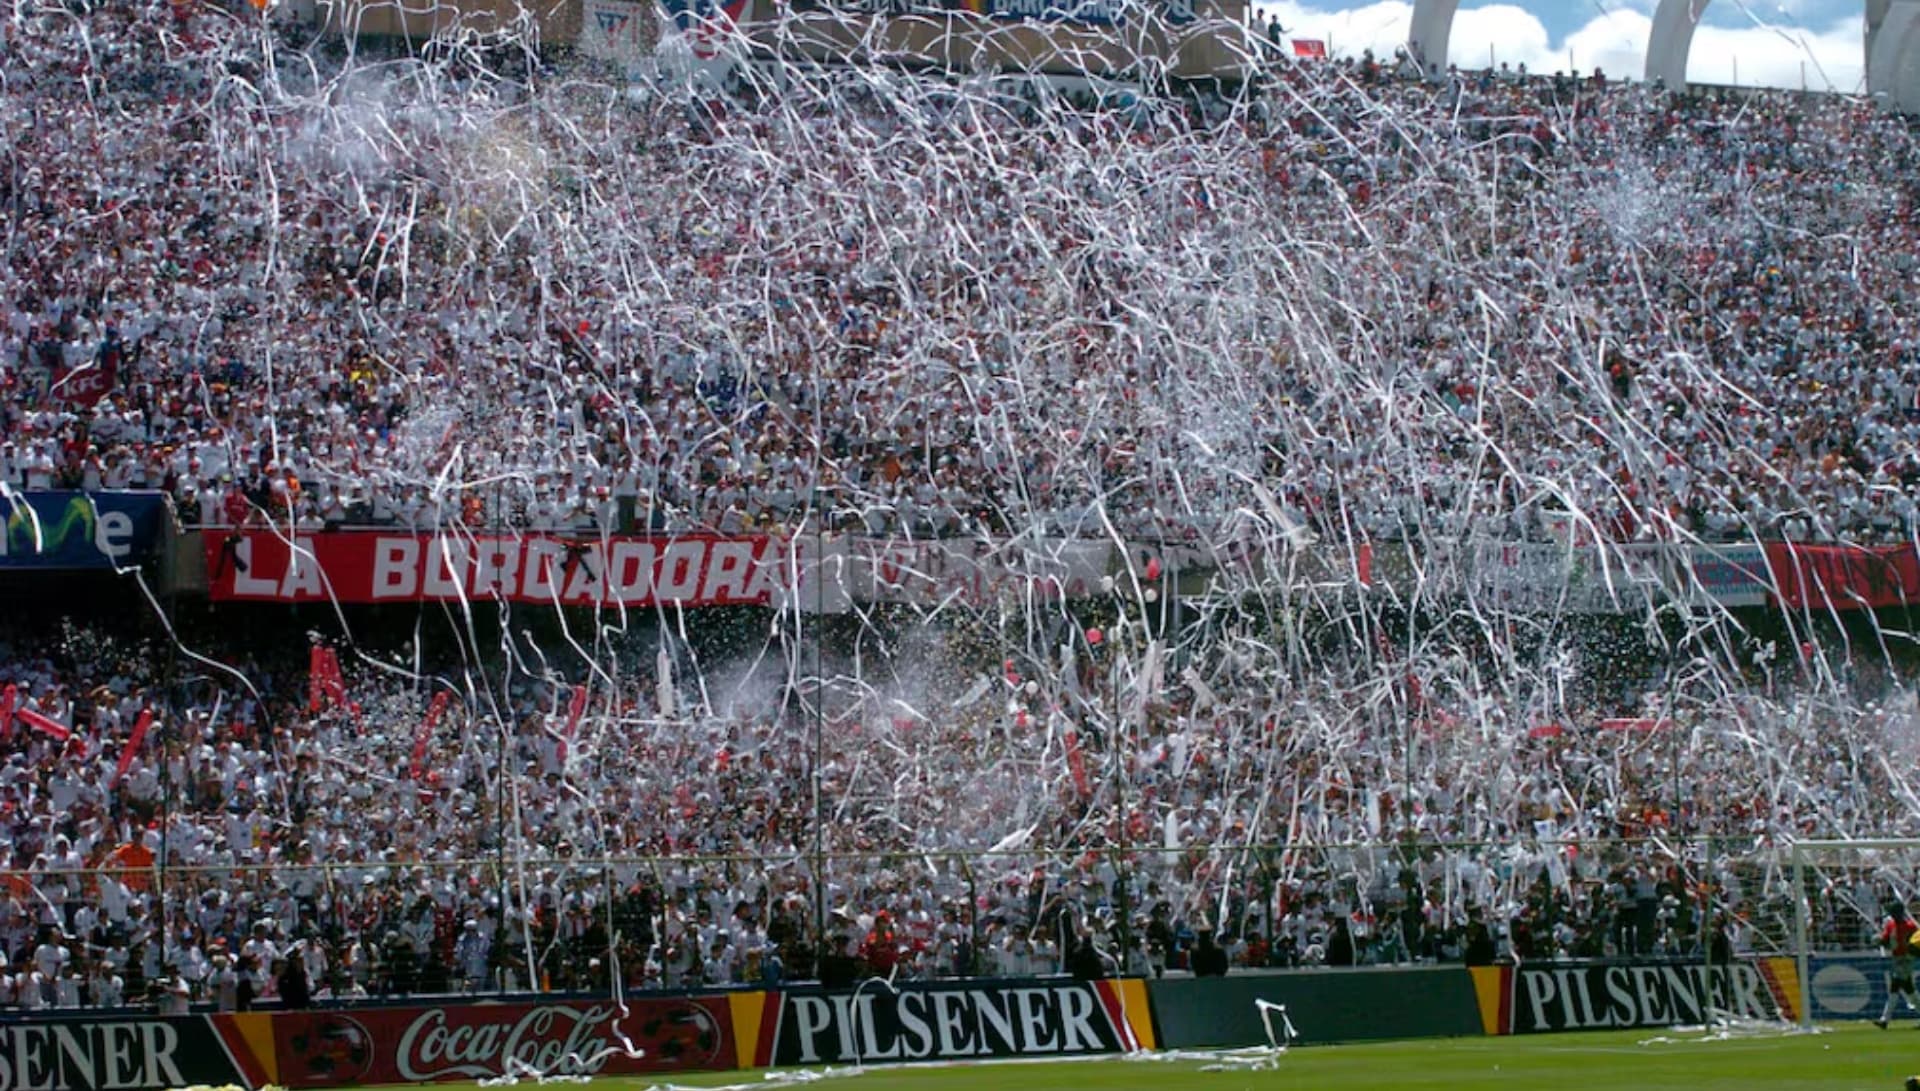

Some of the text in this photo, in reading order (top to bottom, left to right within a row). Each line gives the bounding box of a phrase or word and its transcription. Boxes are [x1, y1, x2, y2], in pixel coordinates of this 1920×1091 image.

[62, 373, 105, 397] KFC
[233, 536, 322, 598] LA
[372, 536, 797, 601] BORDADORA
[790, 986, 1106, 1062] PILSENER
[1521, 959, 1768, 1032] PILSENER
